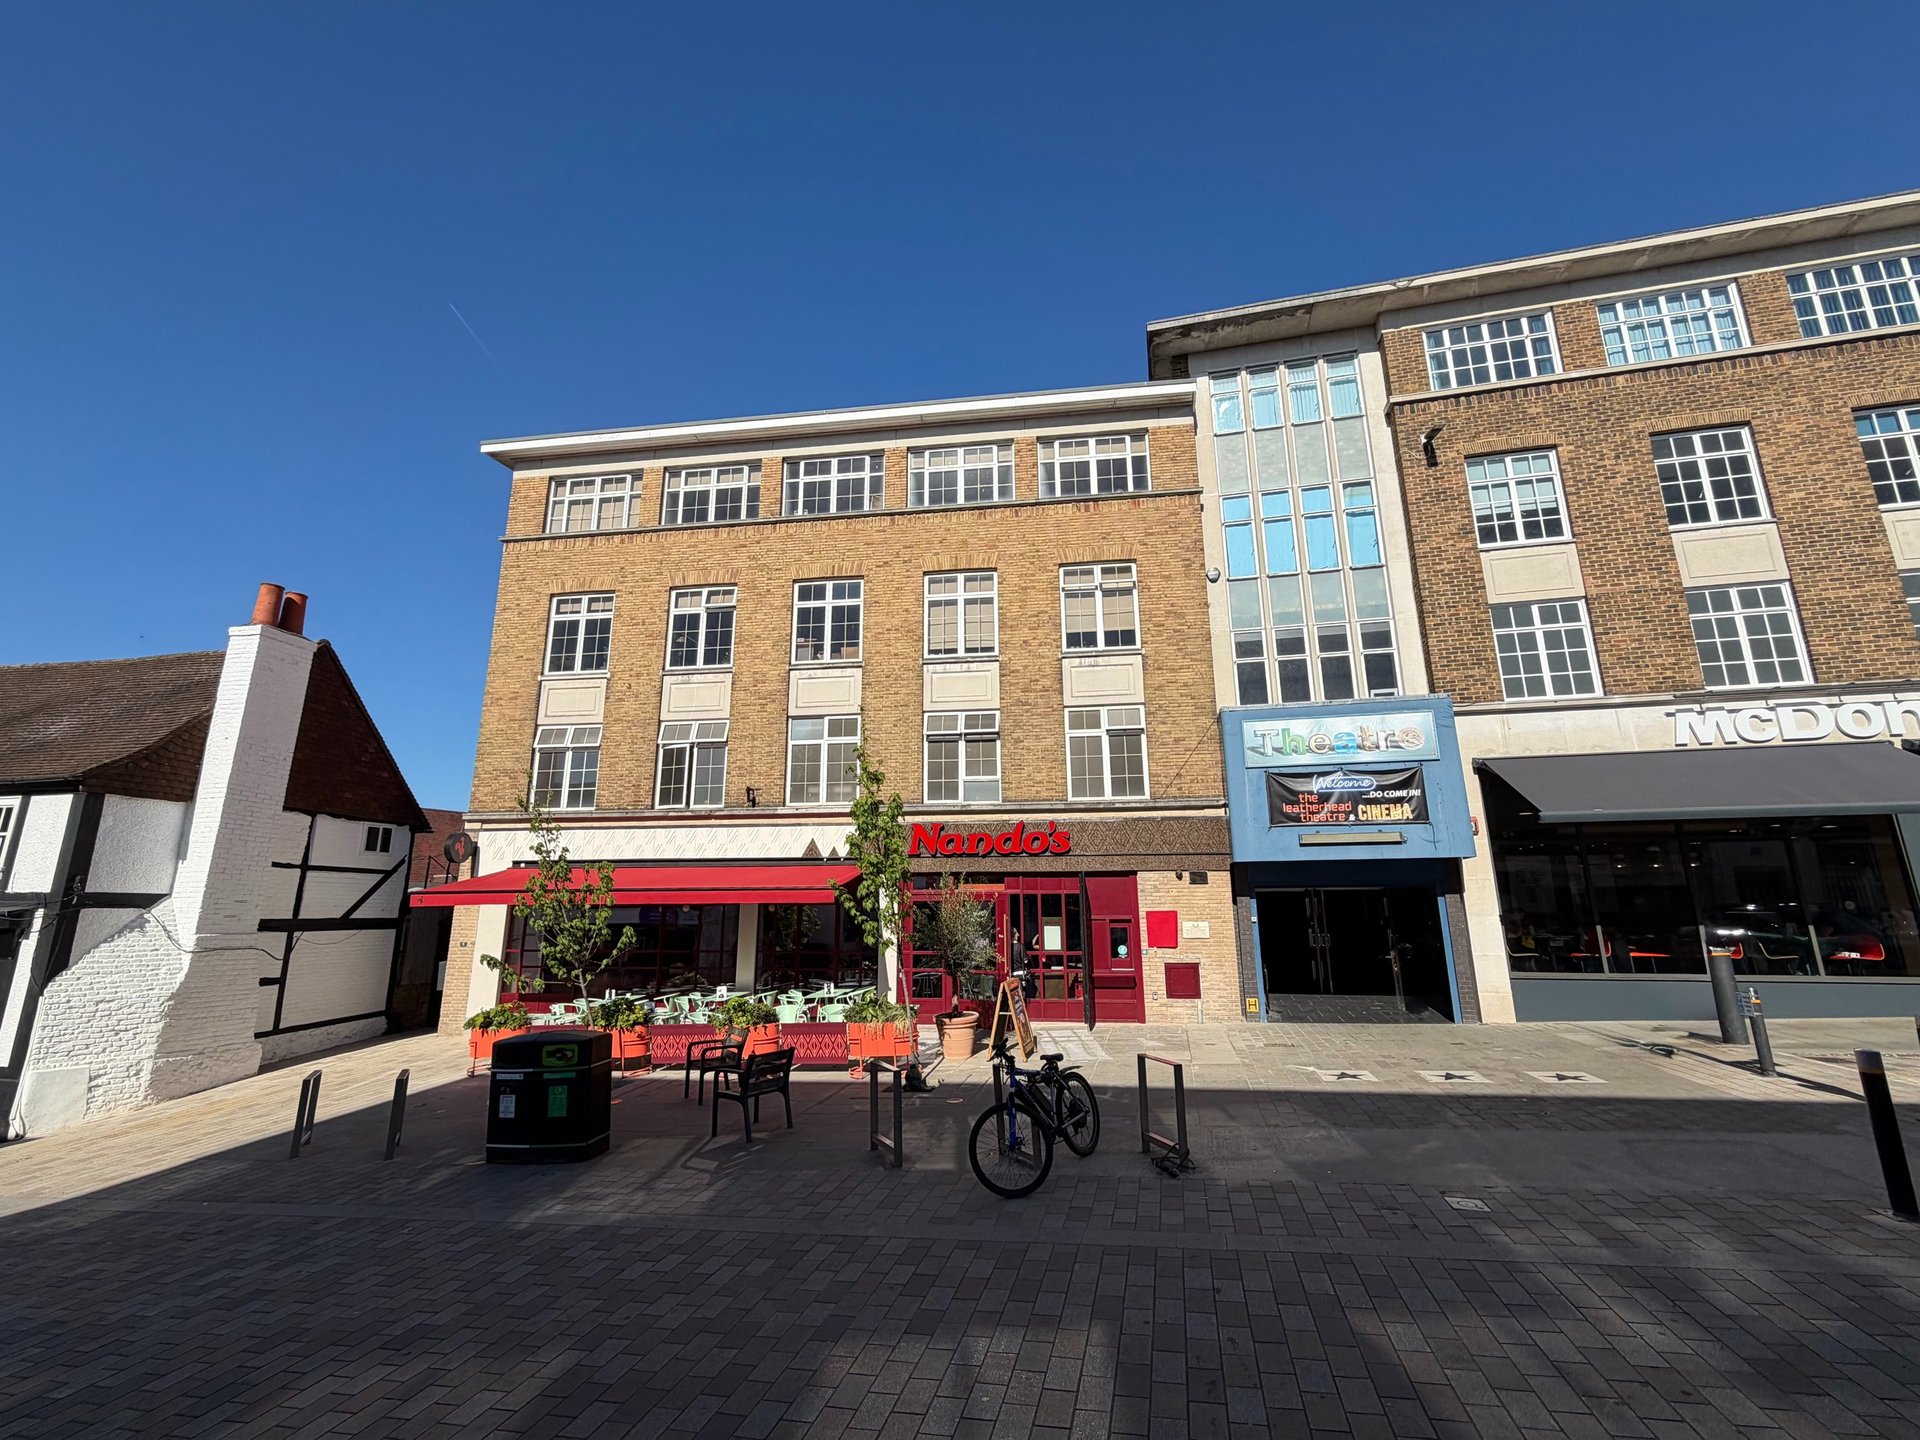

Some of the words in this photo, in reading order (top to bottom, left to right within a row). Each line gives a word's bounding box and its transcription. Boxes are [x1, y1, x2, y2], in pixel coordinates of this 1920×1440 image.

[1253, 726, 1425, 757] Theatre
[1312, 772, 1371, 791] Welcome
[1298, 793, 1318, 803] the
[1384, 790, 1408, 798] COME
[1409, 789, 1422, 797] IN!
[1282, 801, 1352, 813] leatherhead
[1358, 803, 1413, 820] CINEMA
[1300, 812, 1346, 822] theatre
[908, 820, 1072, 857] Nando's
[1248, 999, 1258, 1011] H
